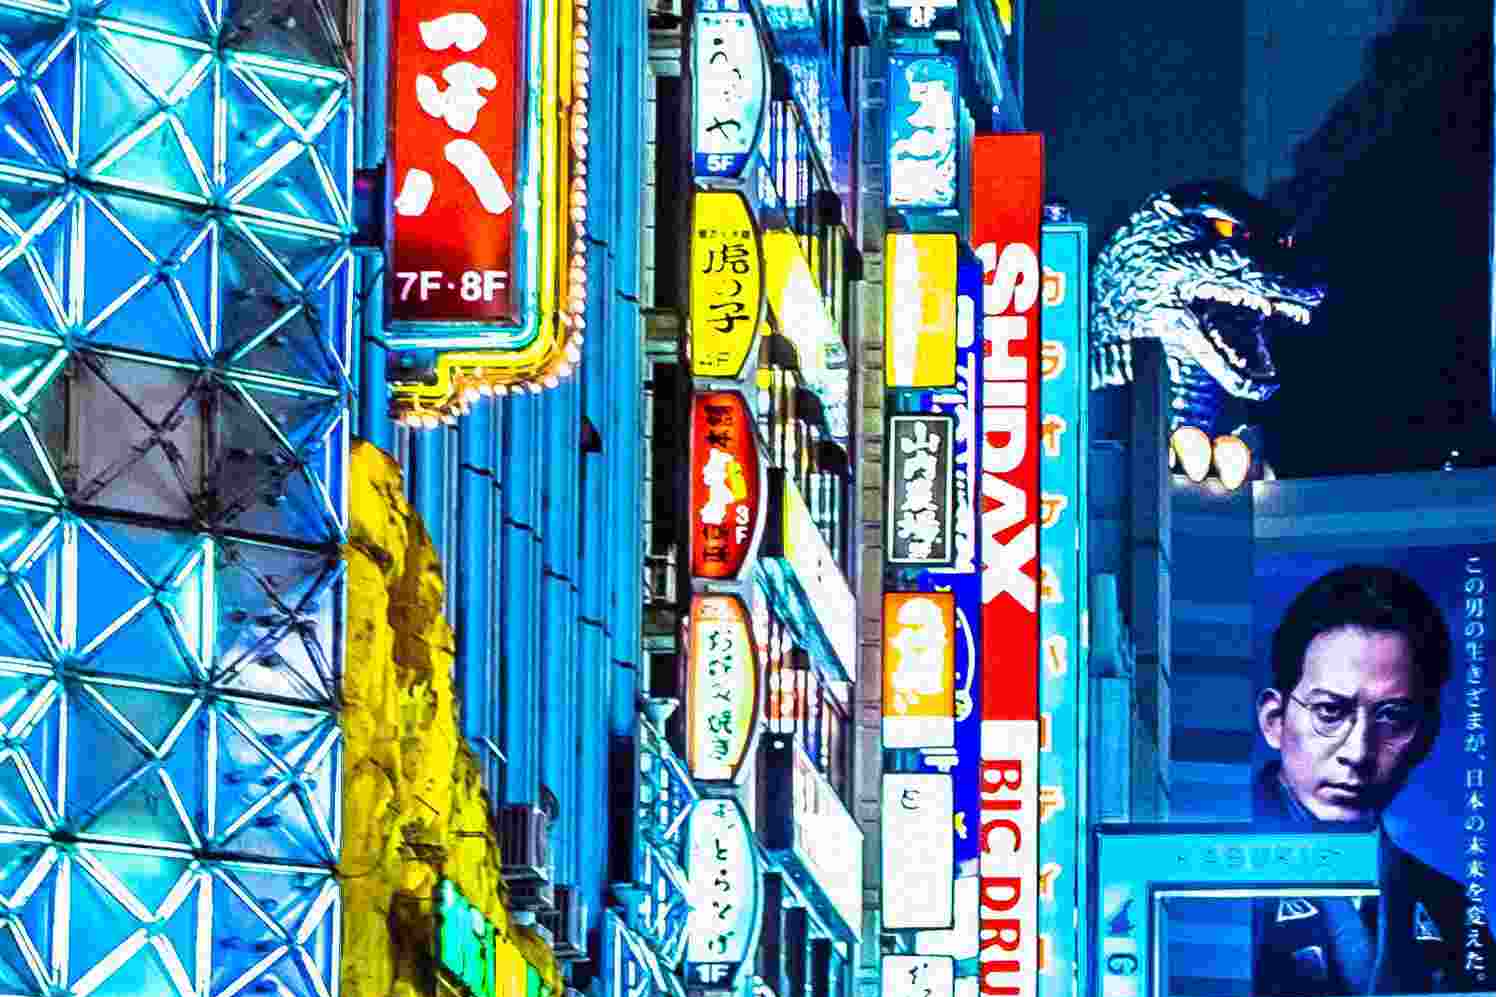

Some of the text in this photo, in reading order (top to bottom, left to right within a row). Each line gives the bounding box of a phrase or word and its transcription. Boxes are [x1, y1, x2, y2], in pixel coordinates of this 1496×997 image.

[707, 155, 734, 171] 5F
[974, 242, 1039, 613] SHIDAX
[980, 759, 1022, 855] BIC
[698, 963, 729, 984] 1F
